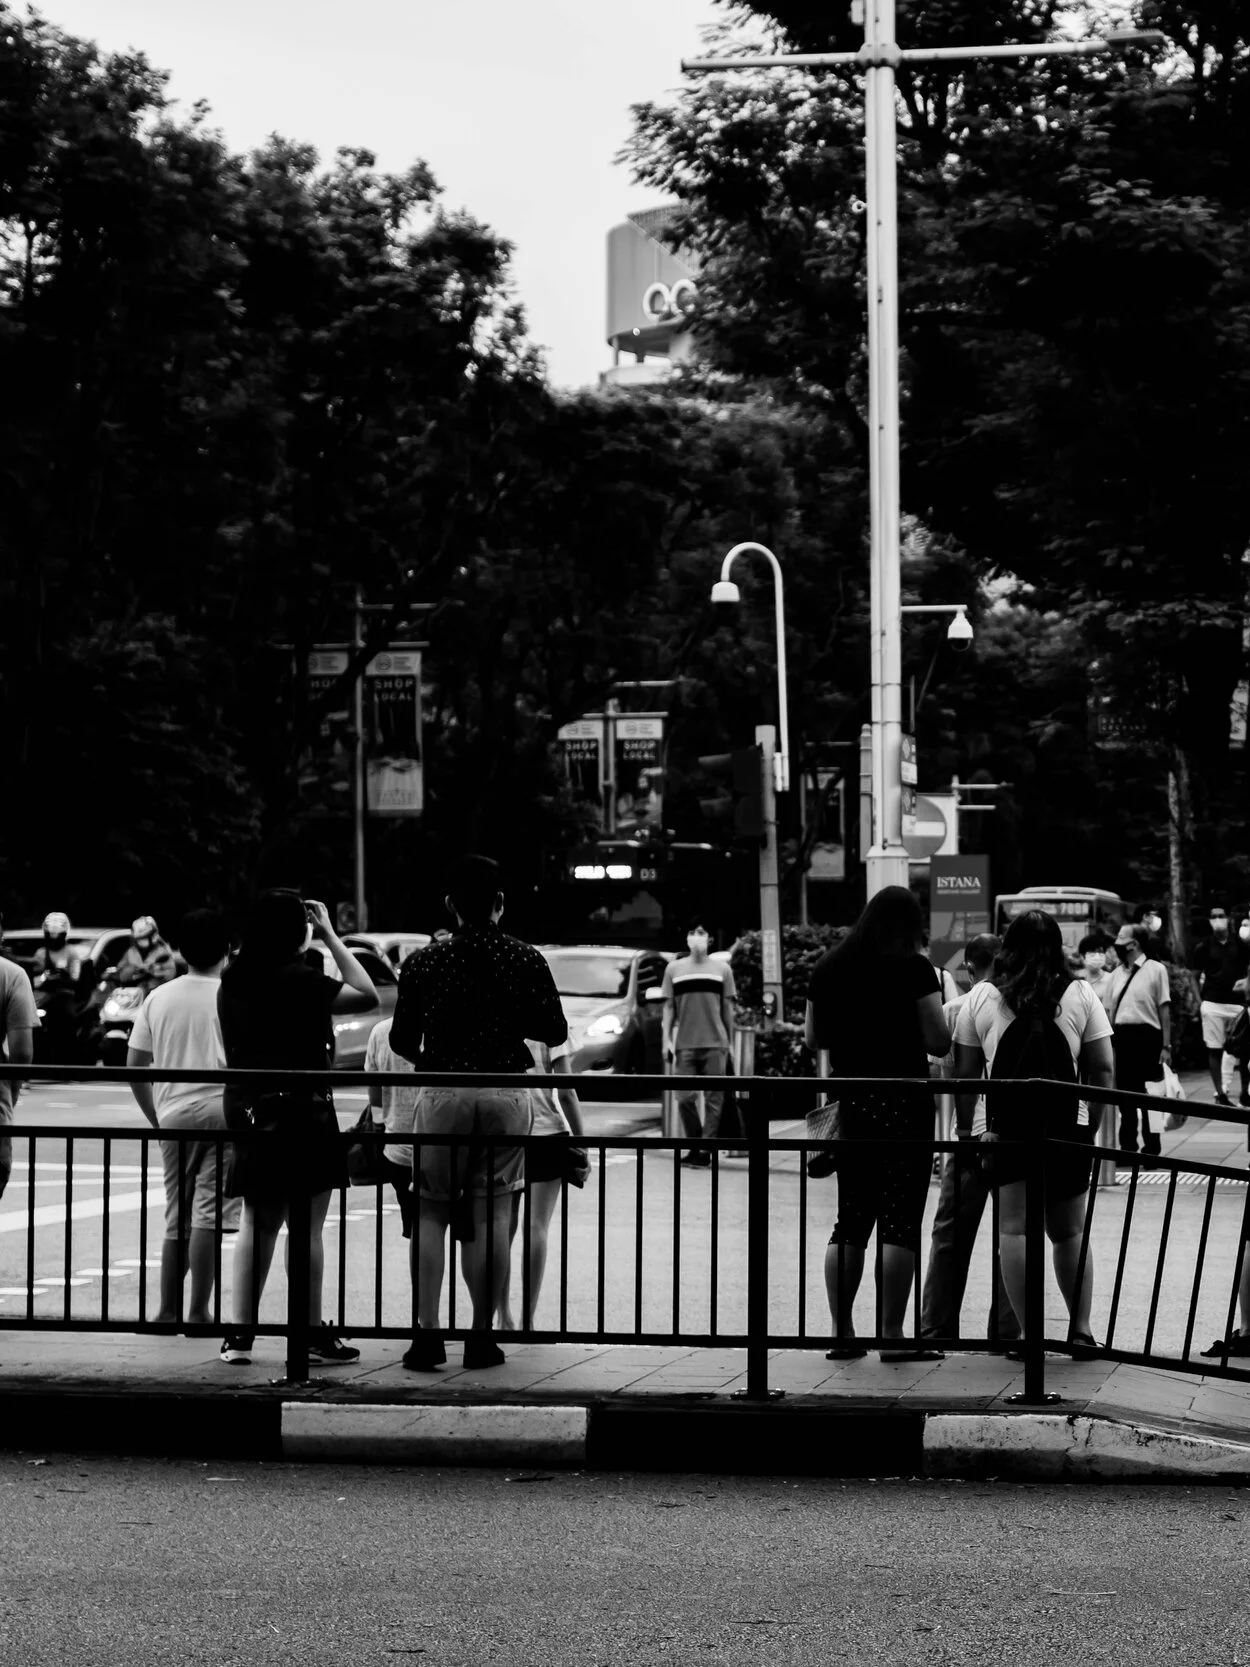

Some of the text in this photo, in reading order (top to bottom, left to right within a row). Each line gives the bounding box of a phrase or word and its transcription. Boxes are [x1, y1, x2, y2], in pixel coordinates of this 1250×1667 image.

[374, 678, 413, 690] SHOP
[374, 691, 413, 702] LOCAL
[565, 740, 597, 750] SHOP
[623, 740, 656, 750] SHOP
[623, 751, 656, 761] LOCAL
[936, 876, 981, 888] ISTANA
